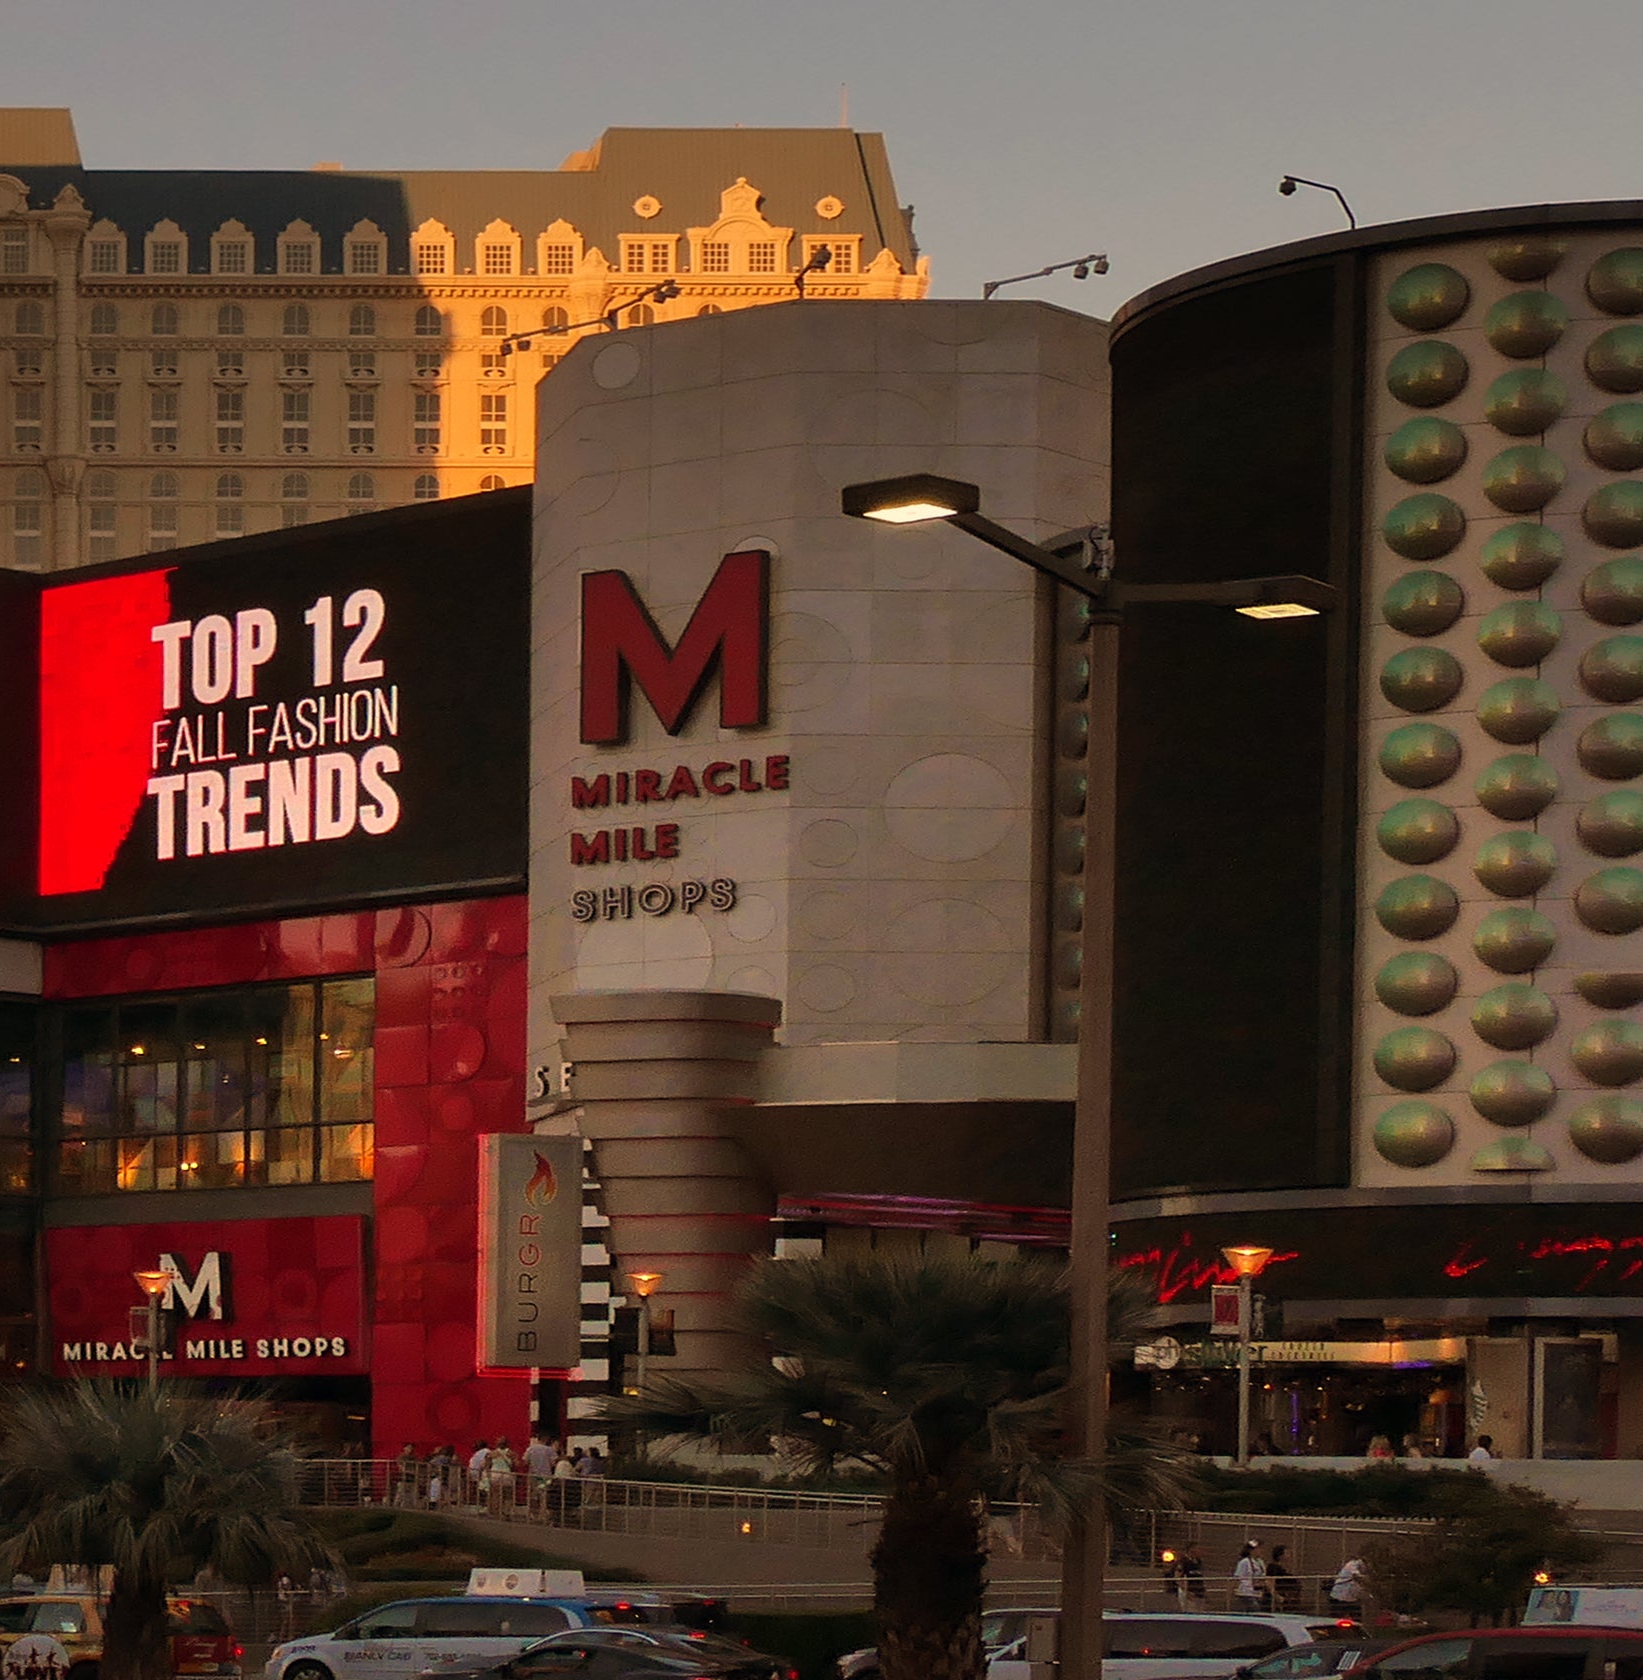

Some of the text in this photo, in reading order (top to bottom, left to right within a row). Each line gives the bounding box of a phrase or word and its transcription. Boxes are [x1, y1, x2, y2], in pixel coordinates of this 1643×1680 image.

[151, 588, 385, 710] TOP 12
[579, 548, 771, 745] M
[150, 684, 399, 770] FALL FASHION
[147, 745, 401, 860] TRENDS
[570, 753, 791, 810] MIRACLE
[570, 821, 682, 866] MILE
[570, 876, 737, 922] SHOPS
[158, 1250, 223, 1321] M
[517, 1213, 543, 1353] BURGR
[62, 1335, 347, 1362] MIRAC MILE SHOPS
